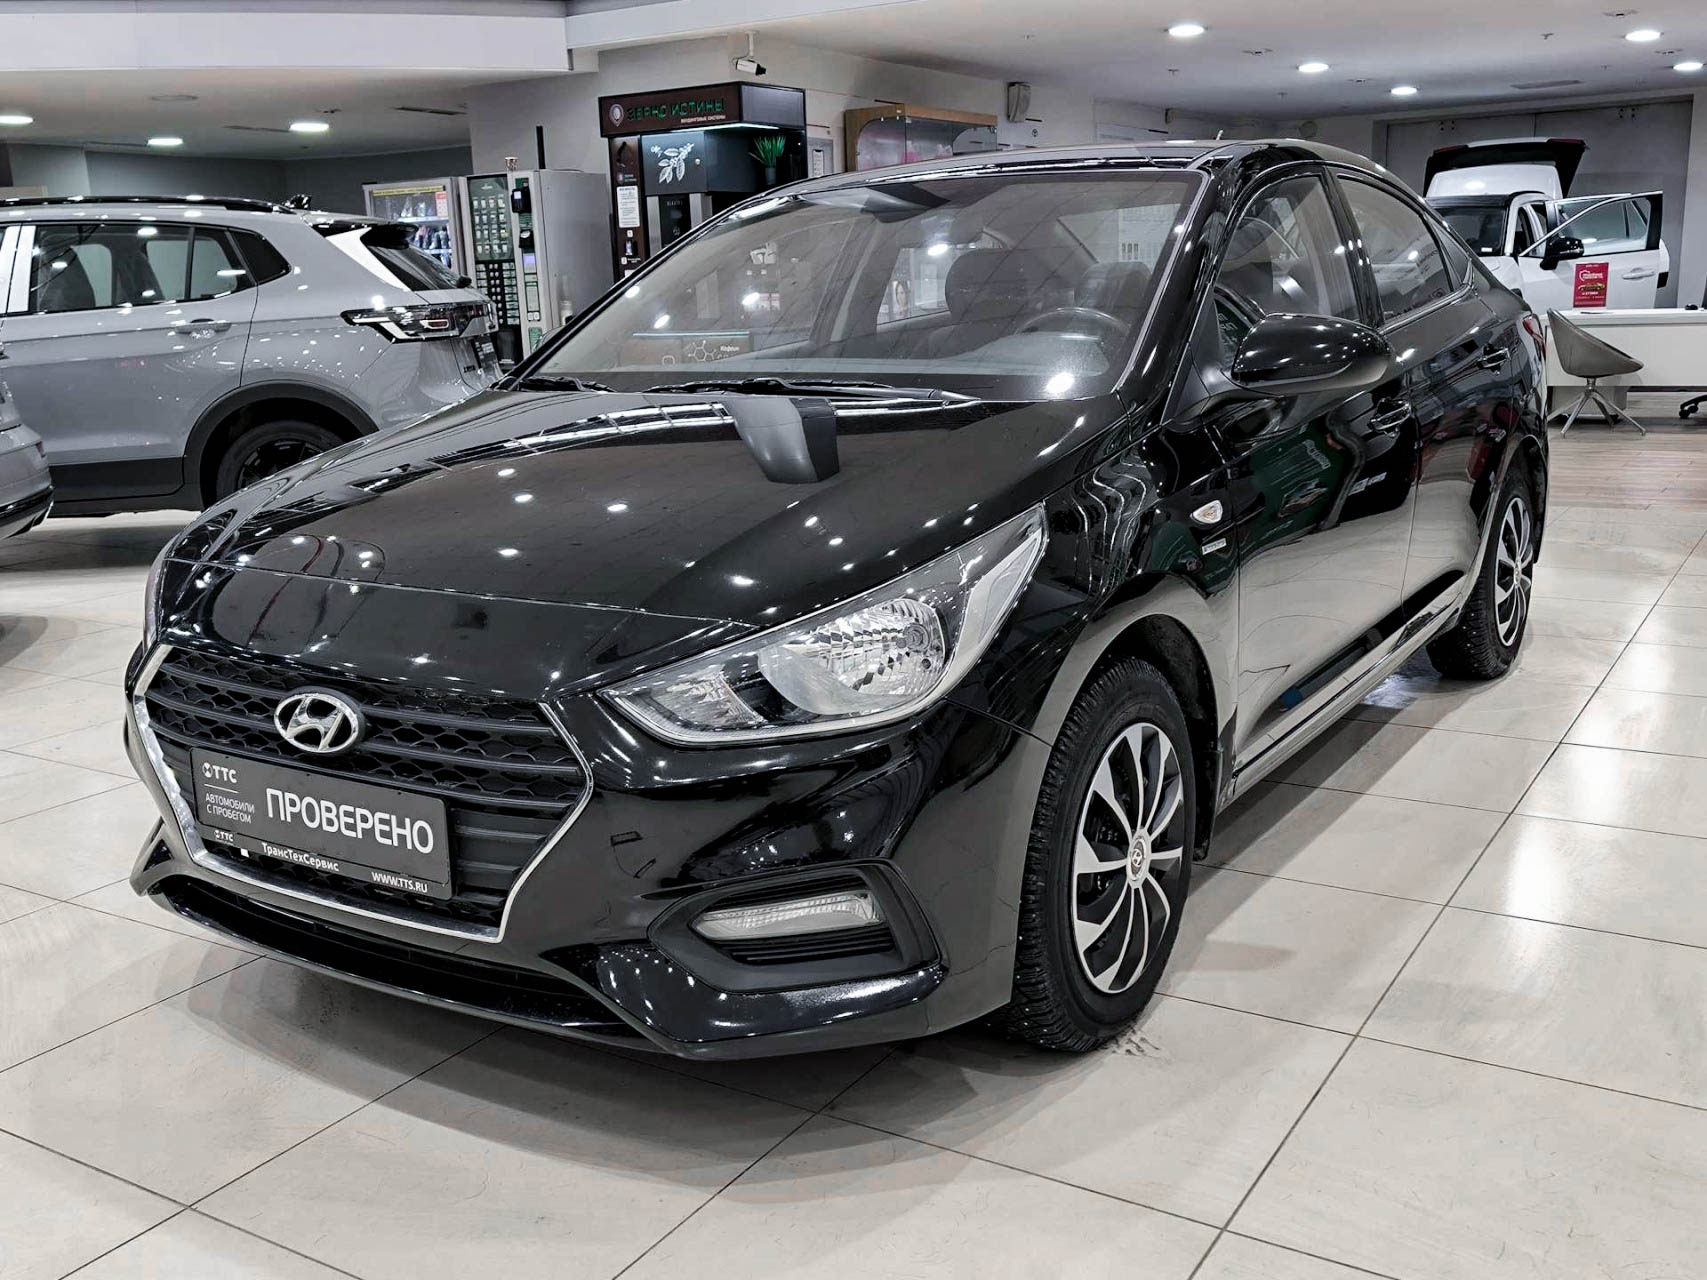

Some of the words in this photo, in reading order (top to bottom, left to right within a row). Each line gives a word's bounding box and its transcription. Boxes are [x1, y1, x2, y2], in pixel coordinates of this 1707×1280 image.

[671, 99, 724, 116] ИСТИНЫ
[213, 766, 237, 784] ТТС
[205, 793, 255, 814] АВТОМОБИЛИ
[206, 803, 213, 813] С
[212, 804, 251, 824] ПРОБЕГОМ
[265, 788, 434, 854] ПРОВЕРЕНО
[262, 842, 339, 872] ТрансТехСервис
[371, 872, 428, 893] WWW.TTS.RU
